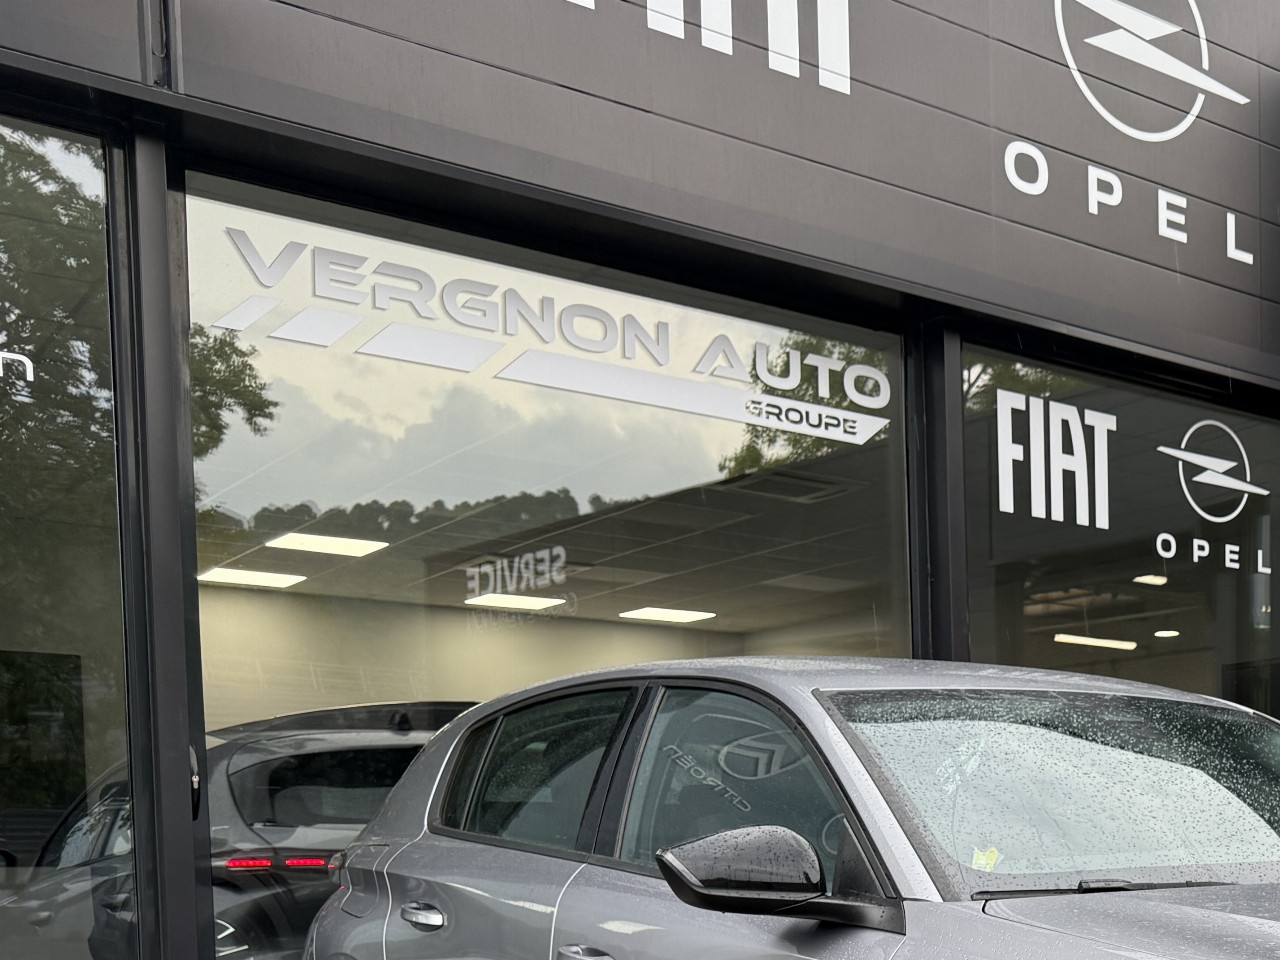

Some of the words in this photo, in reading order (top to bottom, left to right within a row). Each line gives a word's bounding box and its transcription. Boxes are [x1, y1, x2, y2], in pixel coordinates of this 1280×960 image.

[1003, 140, 1255, 266] OPEL
[225, 226, 670, 369] VERGNON
[693, 334, 892, 411] AUTO
[744, 399, 858, 436] GROUPE
[996, 389, 1117, 531] FIAT
[1155, 532, 1272, 575] OPEL
